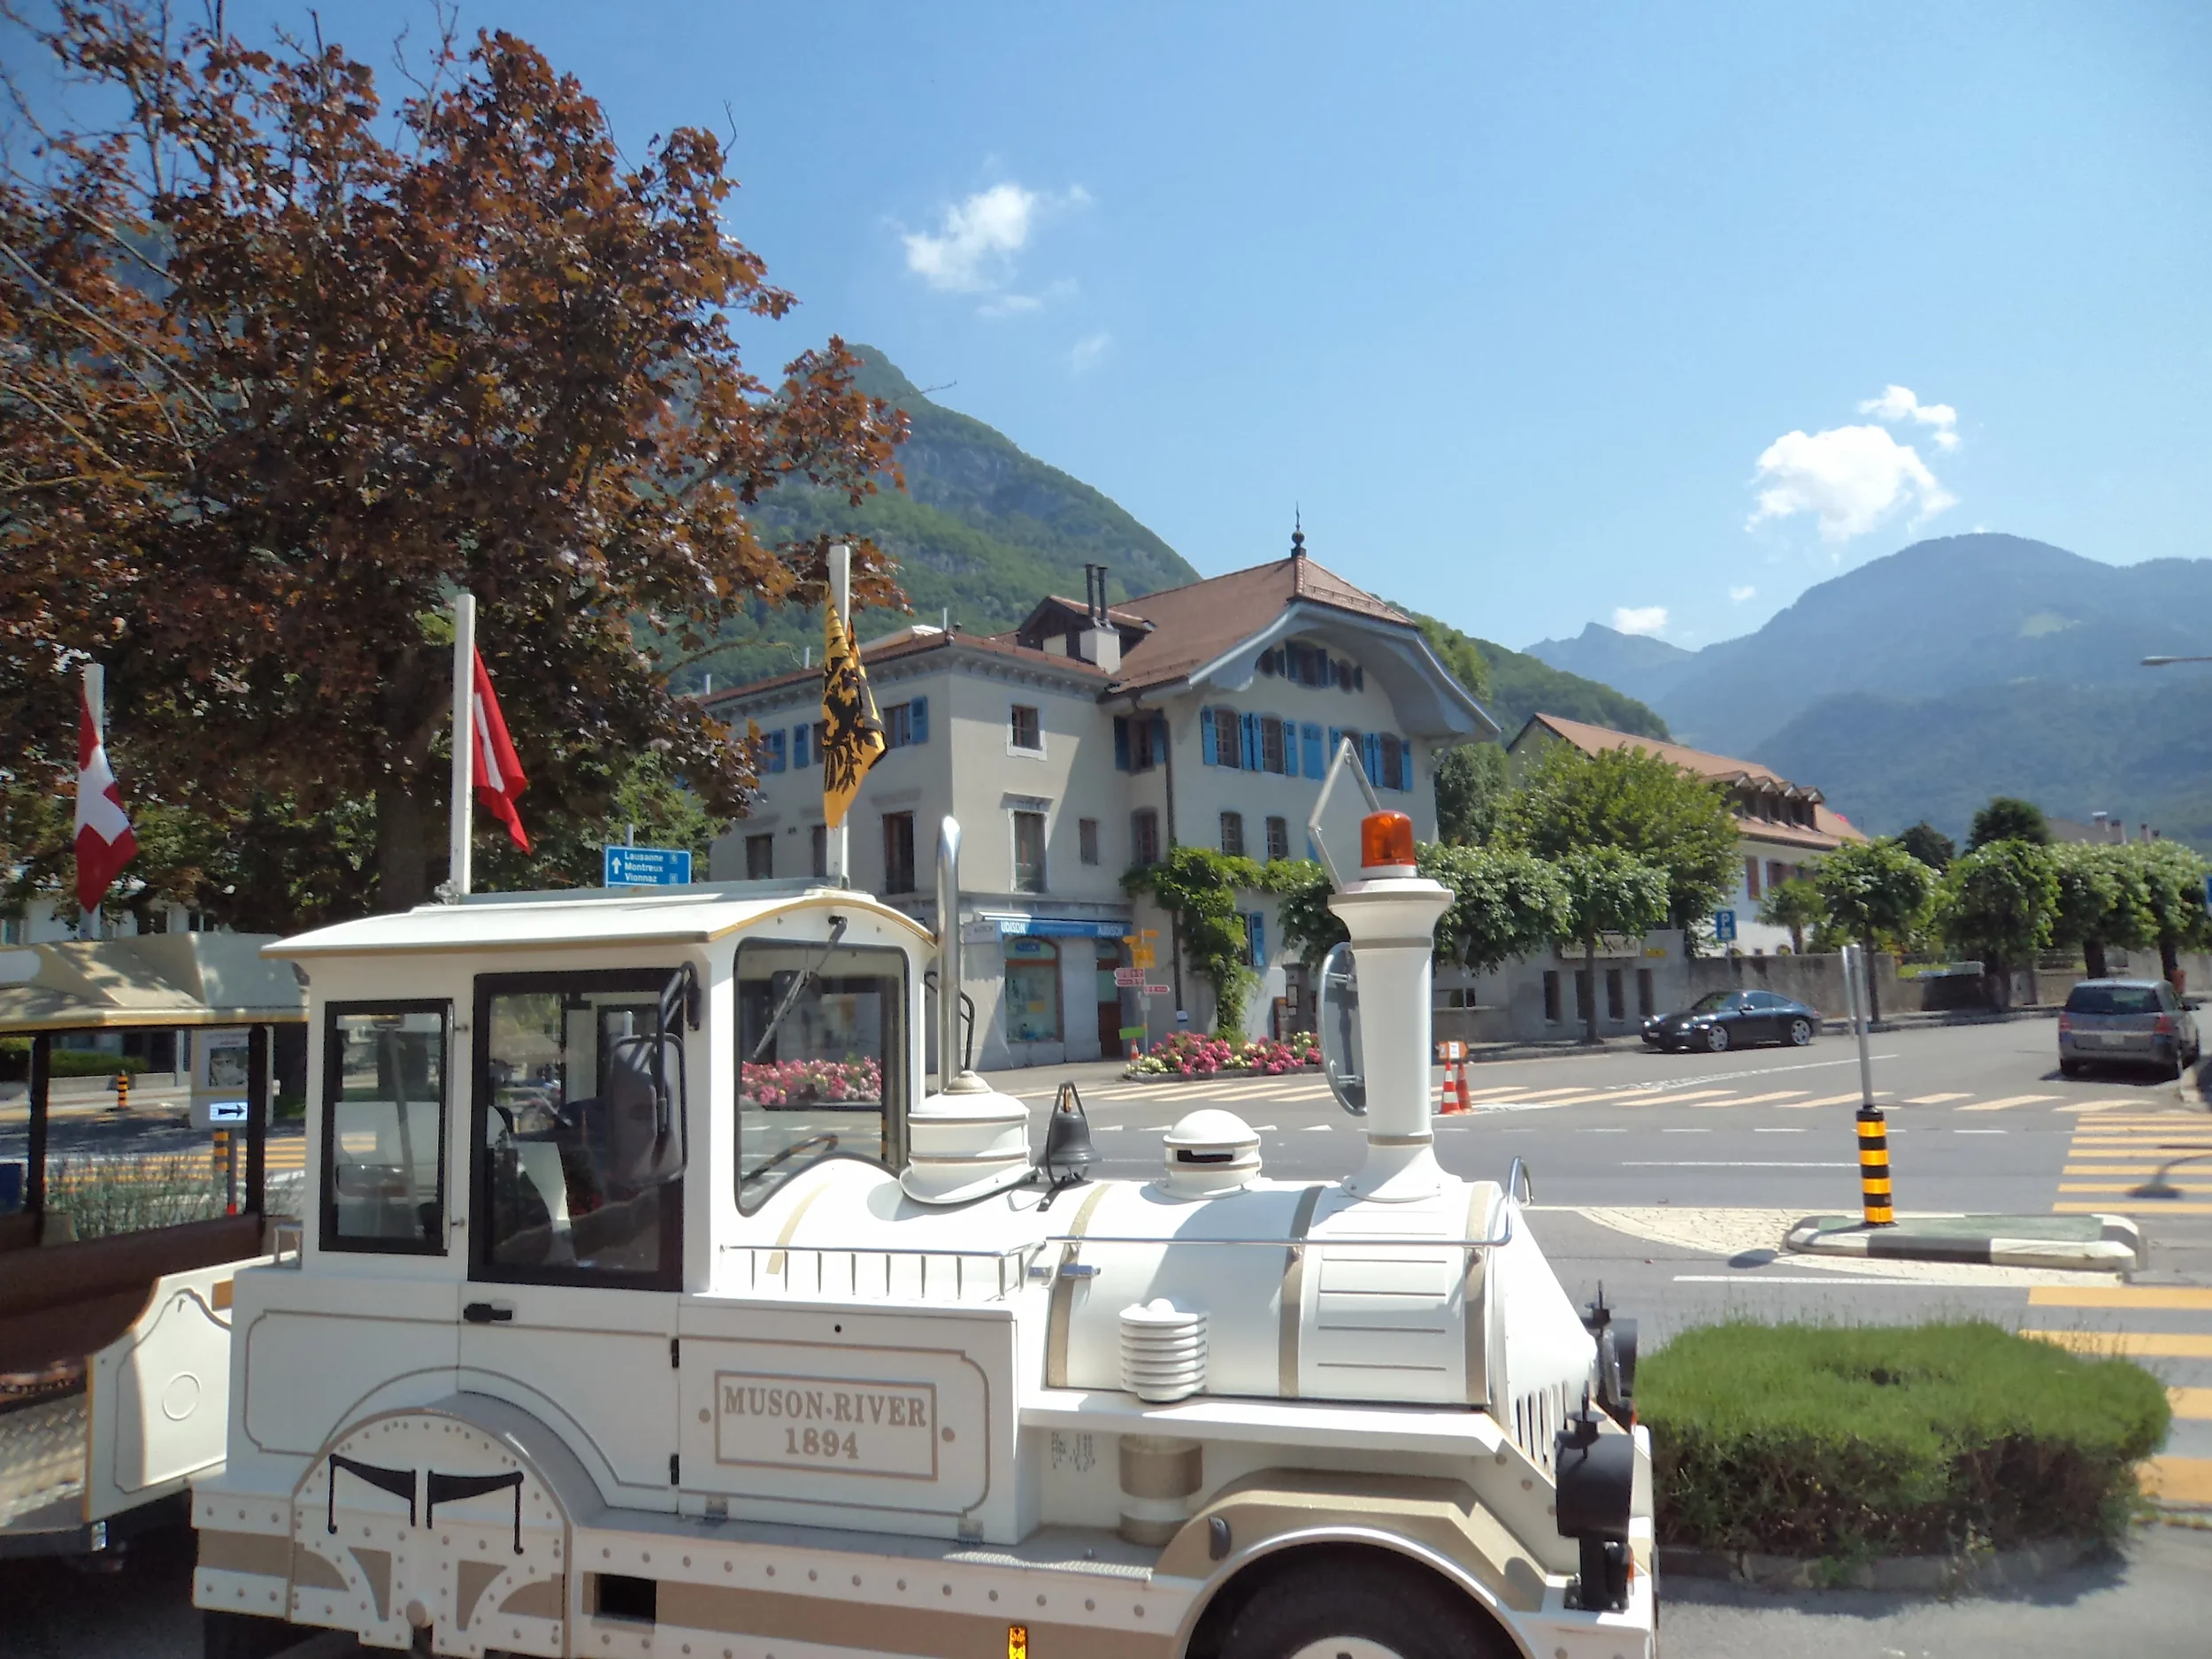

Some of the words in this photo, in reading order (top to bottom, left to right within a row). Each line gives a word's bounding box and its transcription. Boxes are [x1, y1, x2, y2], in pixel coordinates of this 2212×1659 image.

[624, 851, 664, 862] Lausanne
[624, 862, 664, 872] Montreux
[625, 872, 657, 883] Vionnaz
[1720, 912, 1731, 927] P
[785, 1427, 860, 1460] 1894
